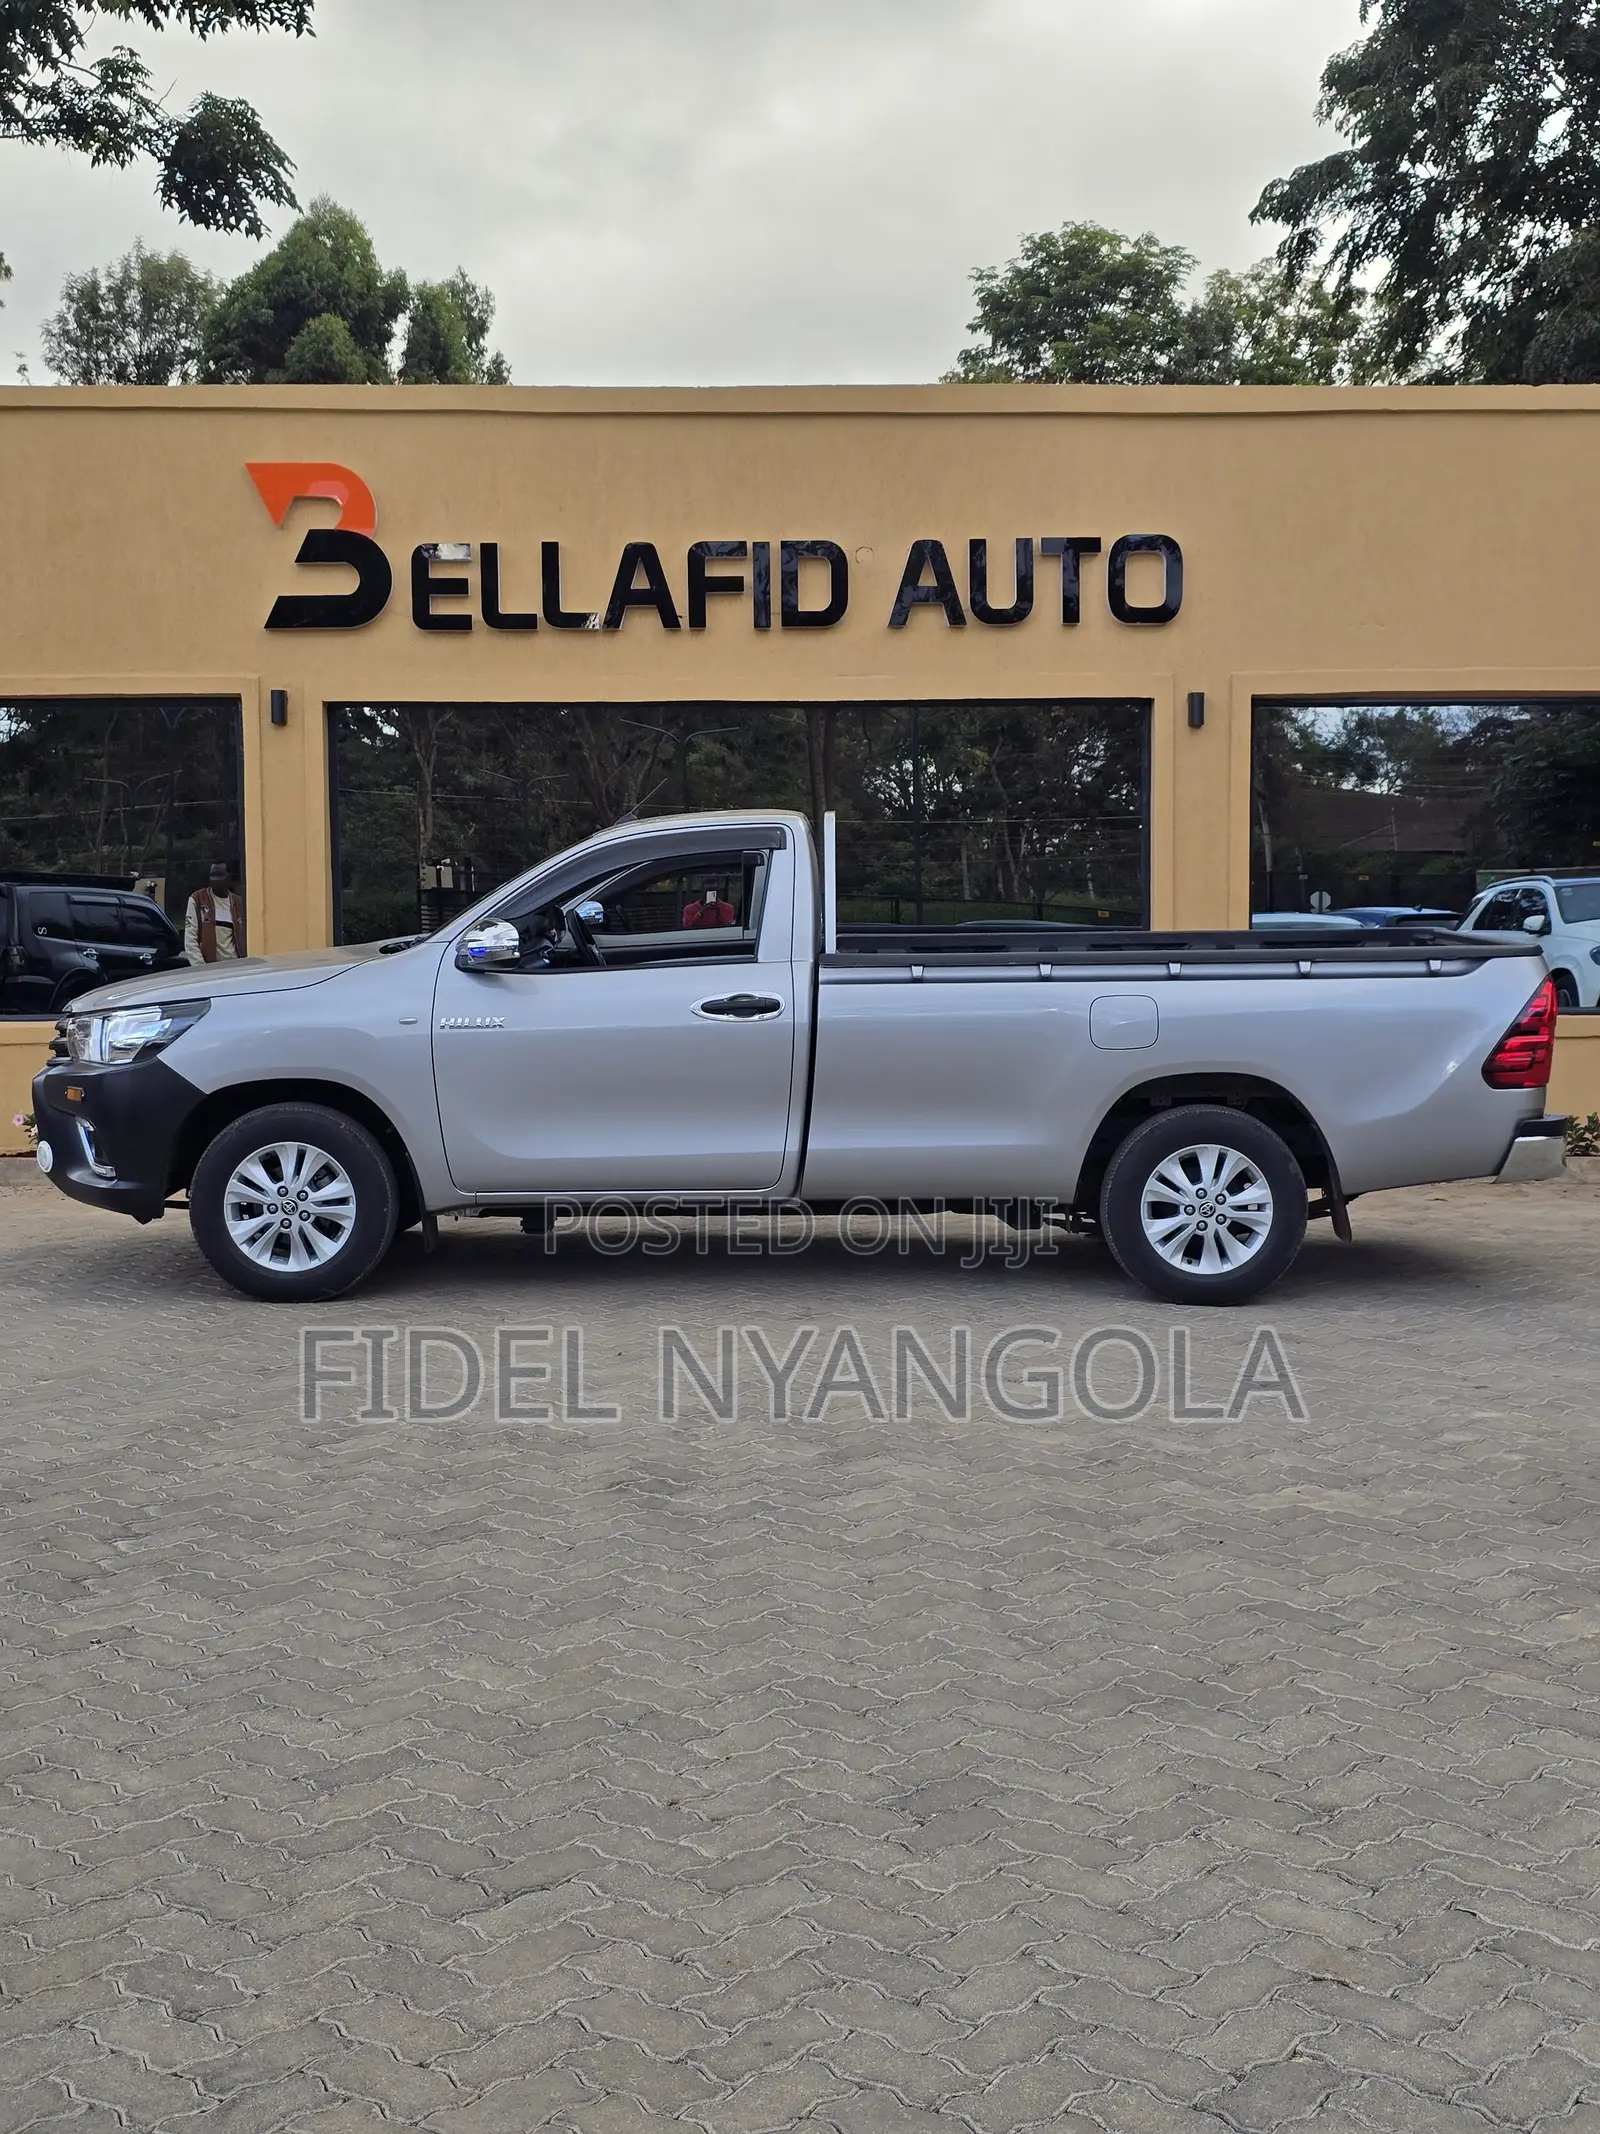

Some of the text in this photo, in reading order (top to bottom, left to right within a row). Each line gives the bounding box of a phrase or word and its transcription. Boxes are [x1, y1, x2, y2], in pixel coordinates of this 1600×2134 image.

[245, 462, 1184, 632] BELLAFID AUTO
[440, 1016, 505, 1030] HILUX
